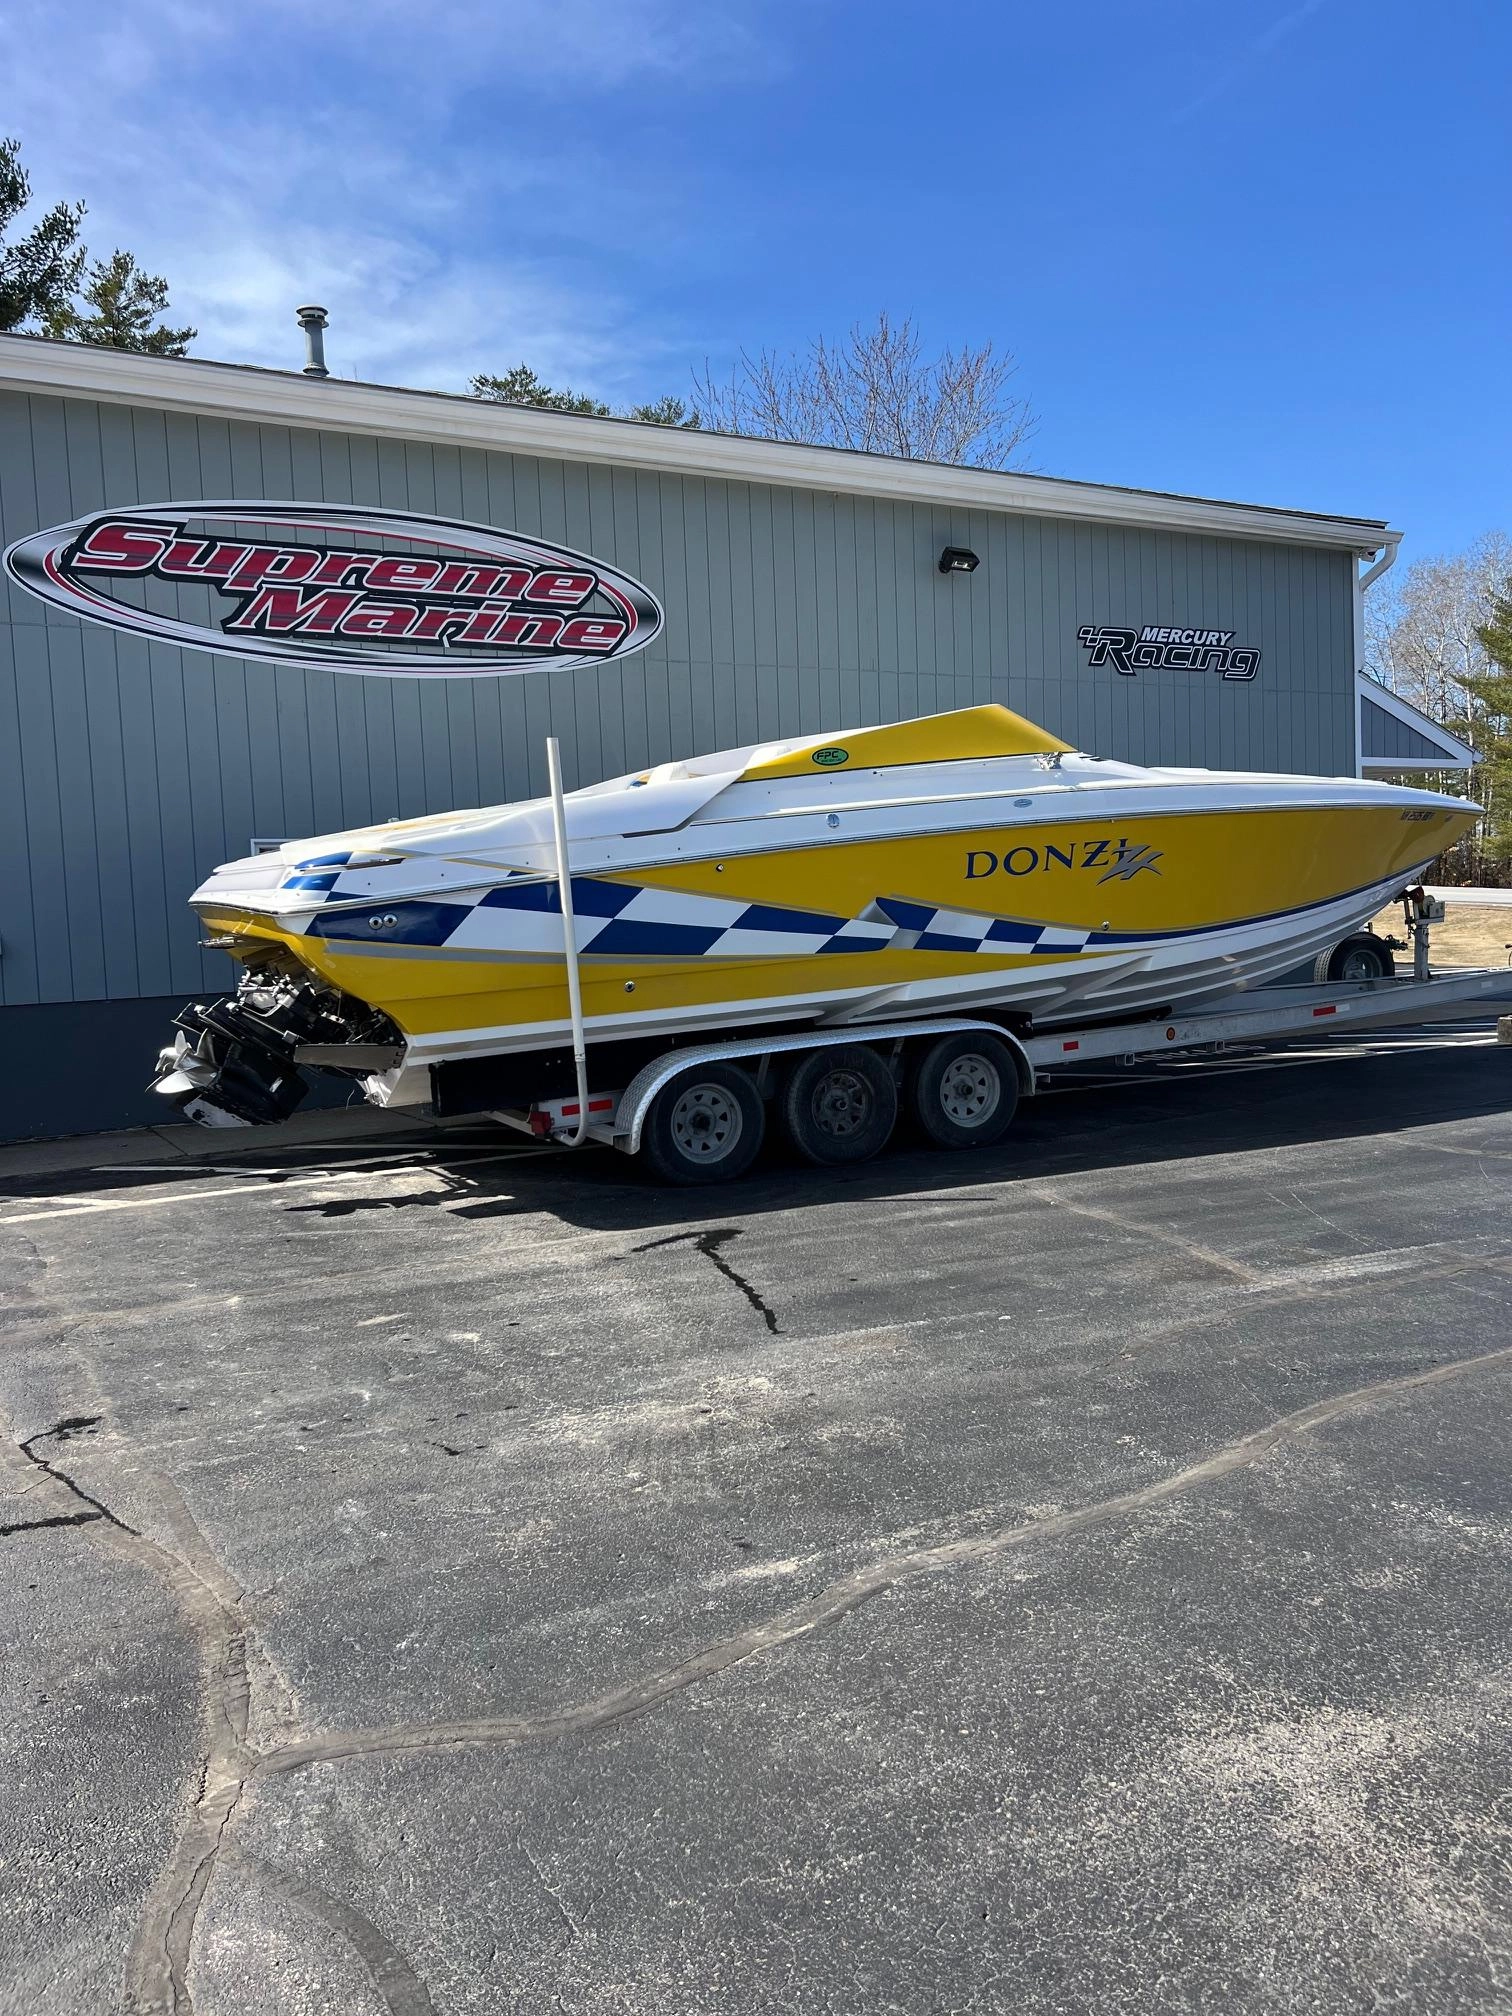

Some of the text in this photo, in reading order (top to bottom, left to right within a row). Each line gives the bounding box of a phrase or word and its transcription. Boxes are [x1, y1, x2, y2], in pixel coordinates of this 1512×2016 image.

[70, 522, 600, 606] Supreme
[233, 584, 628, 650] Marine
[1140, 626, 1233, 646] MERCURY
[1079, 626, 1262, 679] Racing
[963, 838, 1131, 880] DONZI
